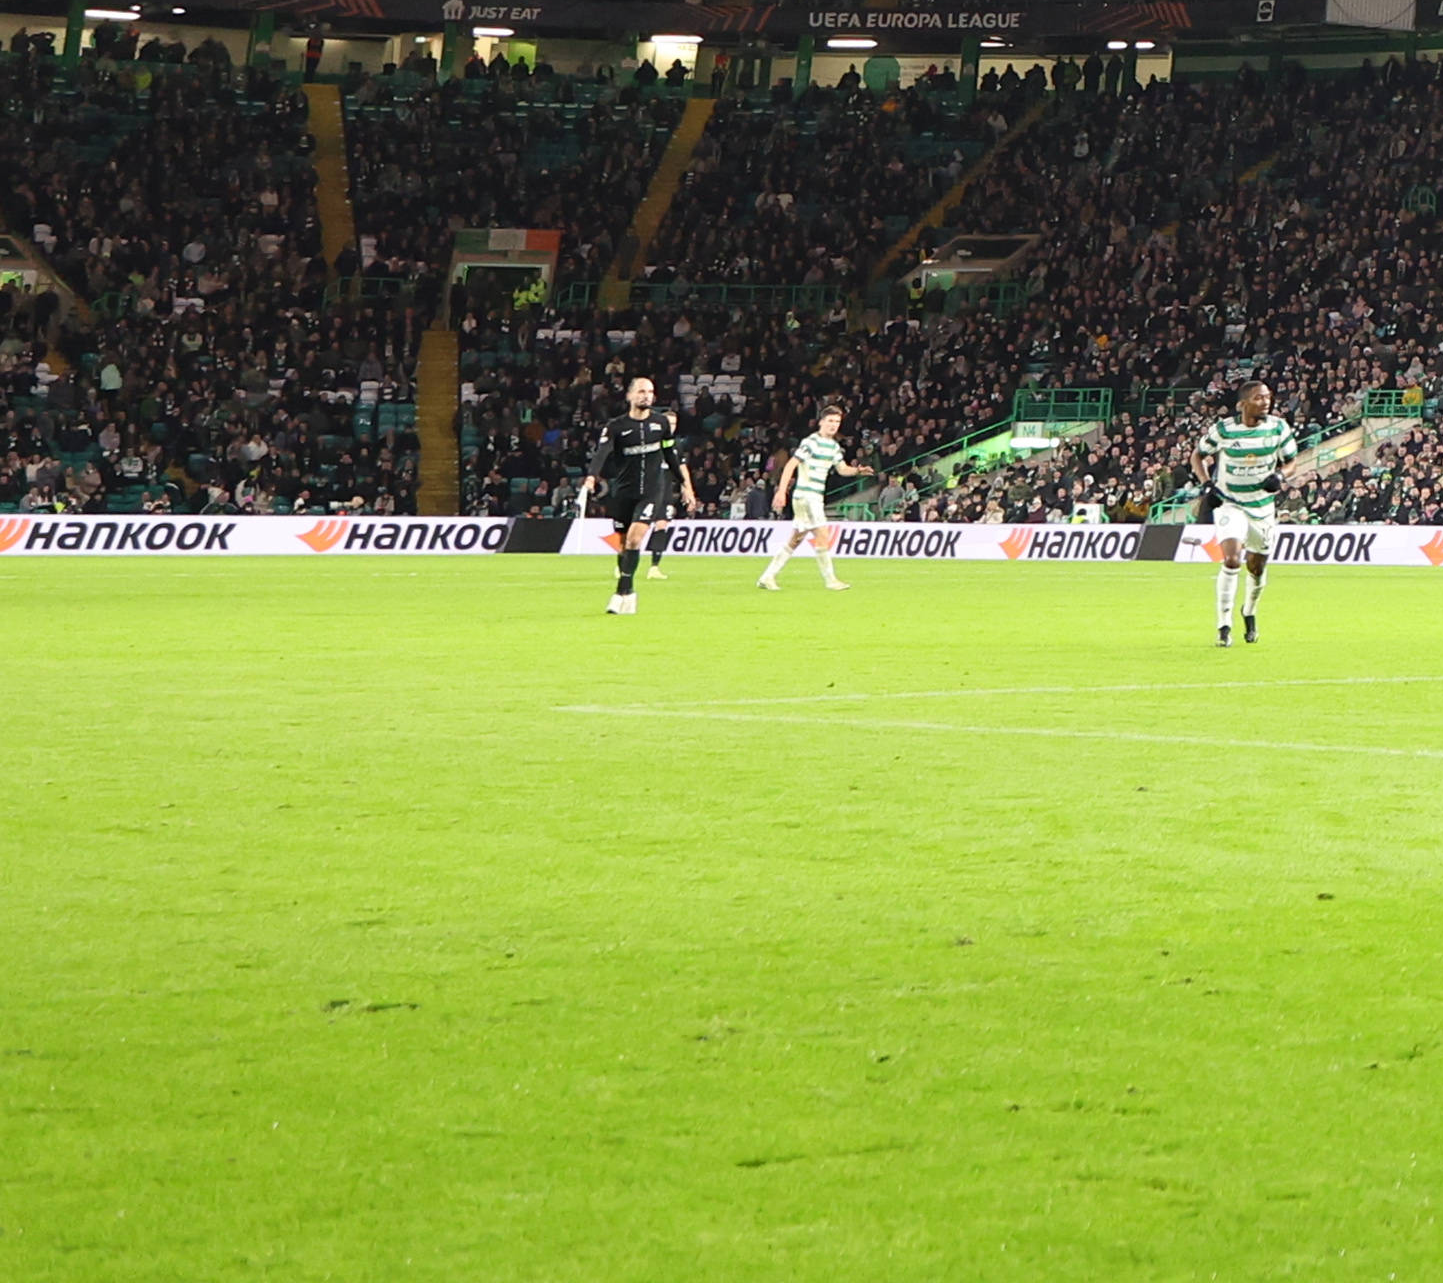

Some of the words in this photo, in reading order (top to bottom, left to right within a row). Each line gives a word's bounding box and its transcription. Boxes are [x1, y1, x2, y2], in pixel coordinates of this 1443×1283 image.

[468, 7, 508, 20] JUST
[510, 7, 541, 20] EAT
[808, 12, 861, 28] UEFA
[865, 12, 942, 28] EUROPA
